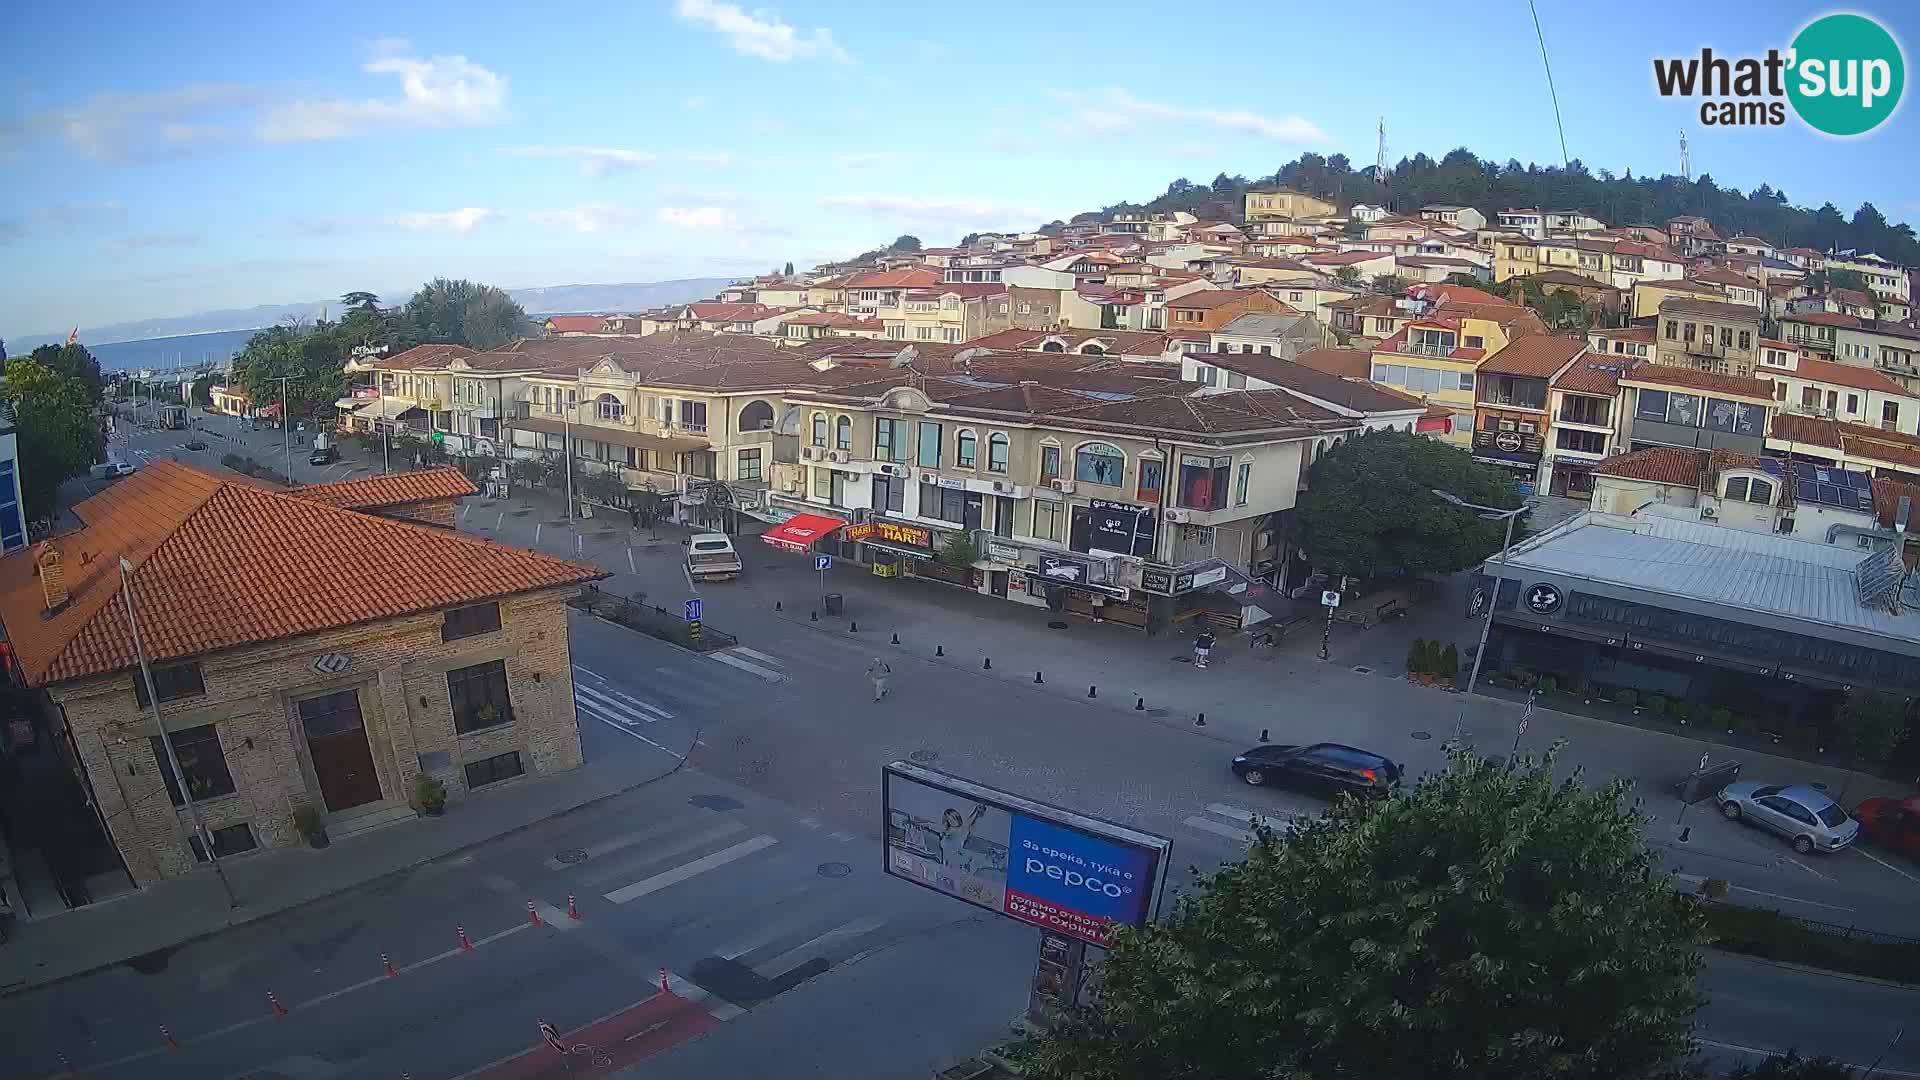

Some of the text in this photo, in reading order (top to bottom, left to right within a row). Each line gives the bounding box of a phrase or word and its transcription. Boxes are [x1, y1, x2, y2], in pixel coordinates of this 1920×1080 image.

[884, 528, 916, 545] HARI
[1022, 839, 1040, 852] За
[1090, 861, 1121, 877] тука
[1123, 872, 1133, 880] е
